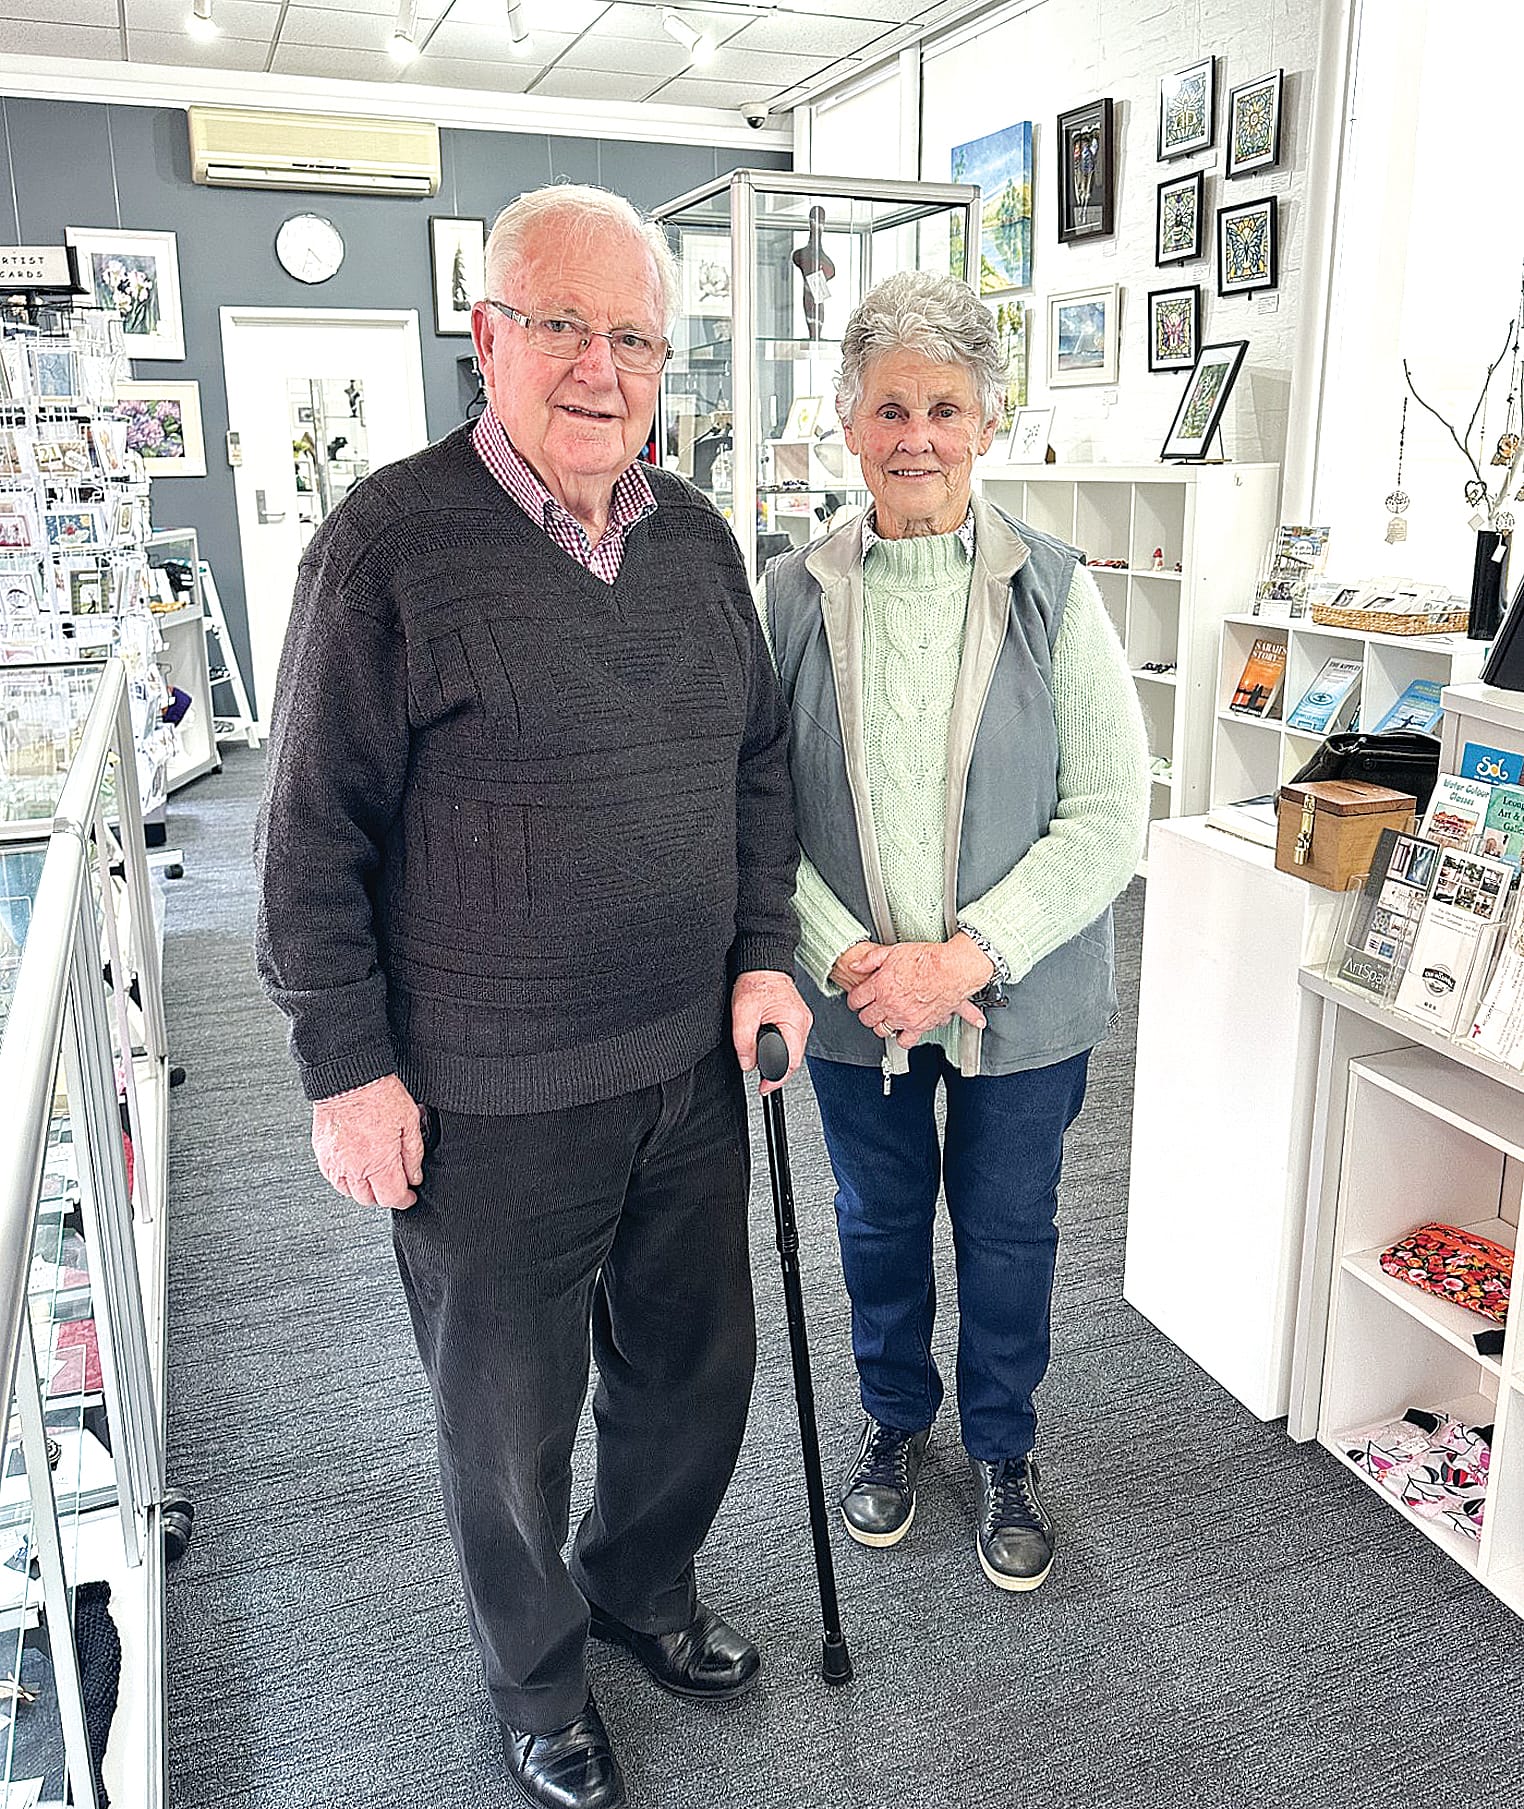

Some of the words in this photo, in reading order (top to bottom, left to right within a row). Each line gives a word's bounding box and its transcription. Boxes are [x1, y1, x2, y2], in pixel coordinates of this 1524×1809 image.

[0, 270, 44, 279] CARDS
[1252, 650, 1277, 662] STORY
[1476, 756, 1509, 781] Sol
[1443, 778, 1465, 791] Water
[1465, 784, 1490, 798] Colour
[1497, 808, 1512, 818] Art
